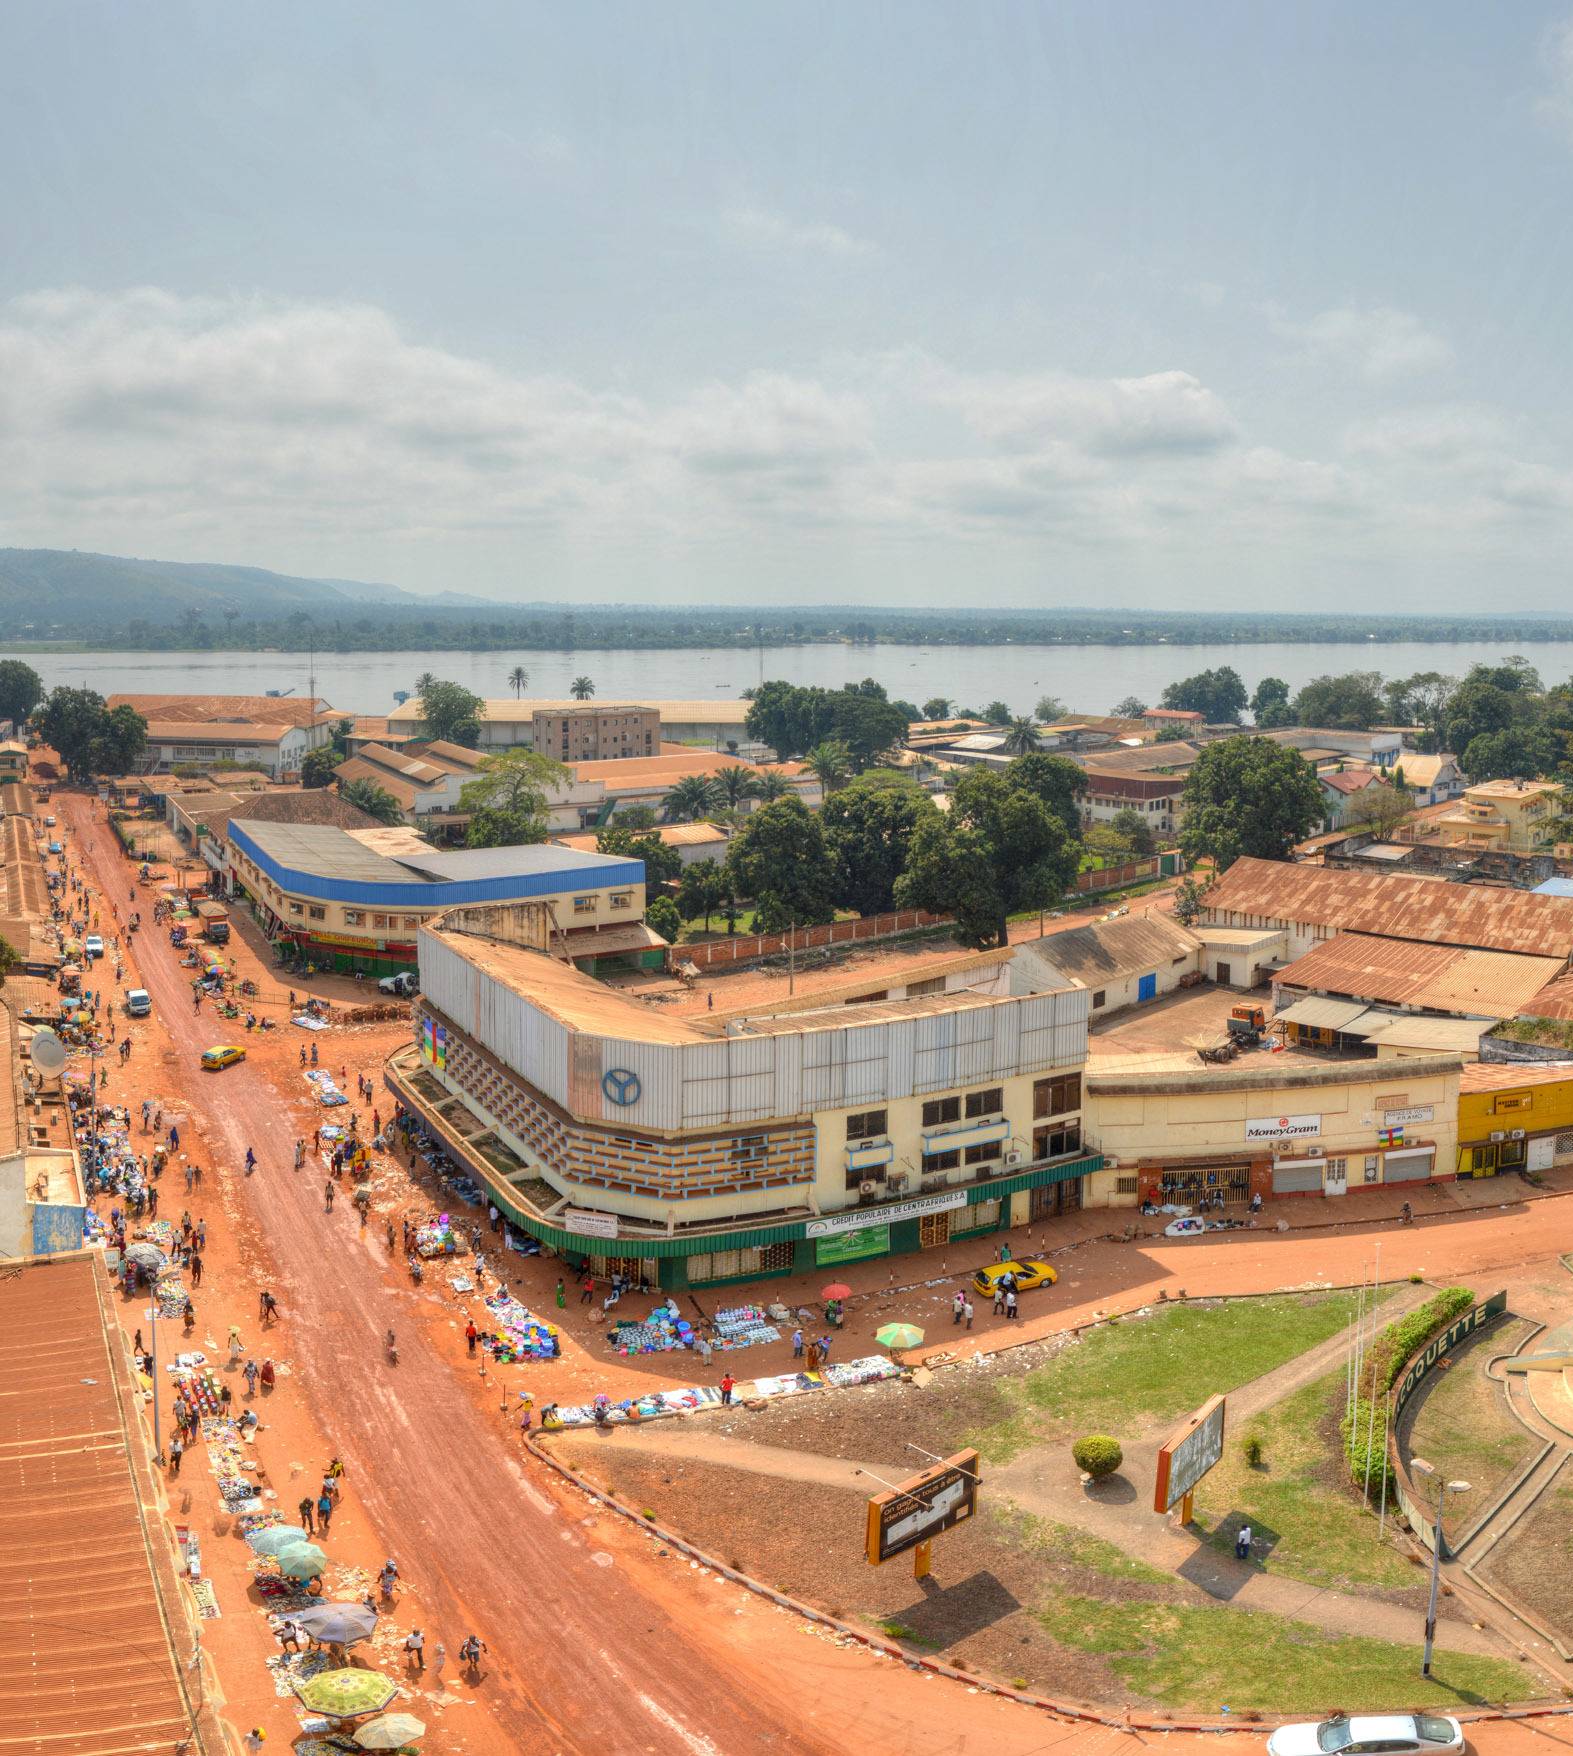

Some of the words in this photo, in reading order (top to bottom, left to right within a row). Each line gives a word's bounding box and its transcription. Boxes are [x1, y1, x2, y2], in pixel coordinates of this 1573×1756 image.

[1247, 1125, 1318, 1137] MoneyGram
[831, 1215, 854, 1226] CREDIT
[856, 1208, 891, 1221] POPULAIRE
[894, 1206, 902, 1214] DE
[903, 1195, 955, 1213] CENTRAFRIQUE
[1400, 1304, 1487, 1404] COQUETTE
[883, 1506, 894, 1516] on
[896, 1494, 920, 1510] gagne
[922, 1484, 939, 1497] tous
[946, 1473, 961, 1485] être
[883, 1502, 919, 1523] identifiés
